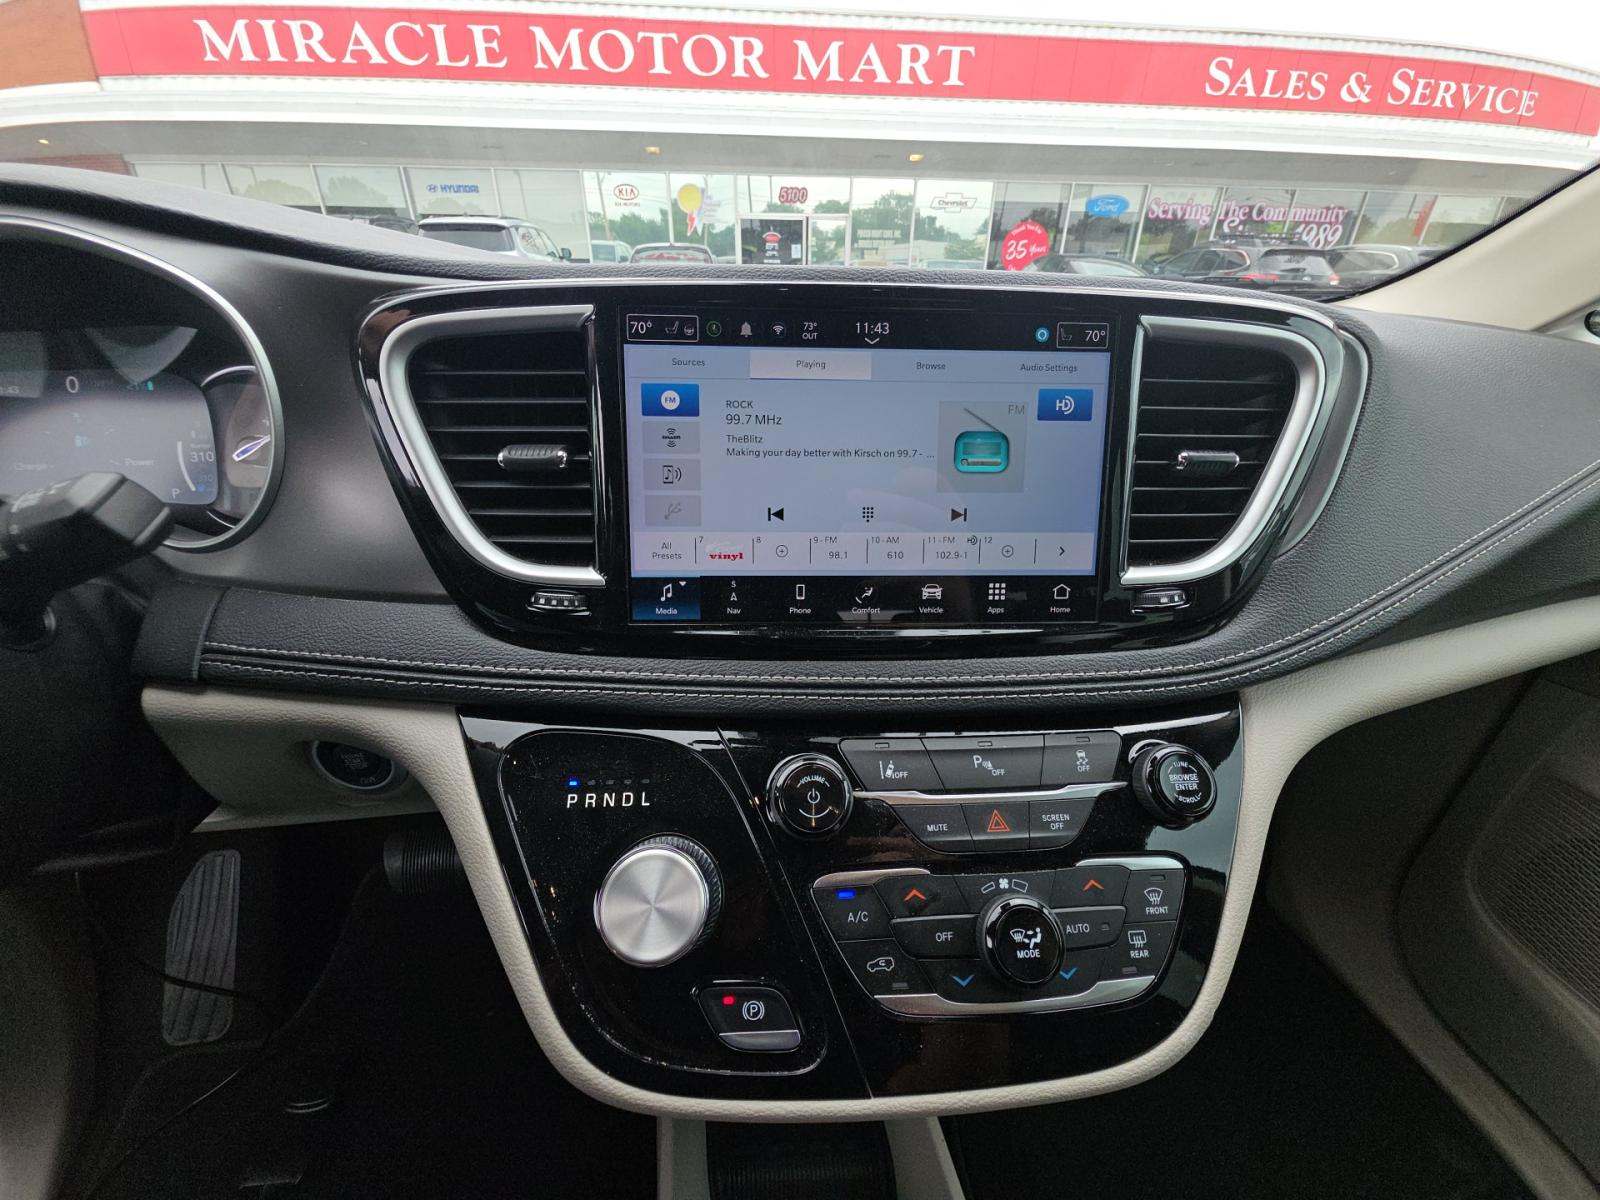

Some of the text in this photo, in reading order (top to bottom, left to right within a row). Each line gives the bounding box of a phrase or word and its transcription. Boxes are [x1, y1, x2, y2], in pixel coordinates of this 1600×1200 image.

[193, 18, 976, 87] MIRACLE MOTOR MART
[1340, 71, 1372, 103] &
[440, 184, 480, 194] HYUNDAI
[618, 187, 637, 197] KIA
[779, 186, 808, 204] 5100
[1148, 196, 1212, 225] Serving
[1218, 200, 1249, 220] The
[1252, 200, 1349, 225] Community
[1005, 239, 1029, 261] 35
[855, 322, 890, 335] 11:43
[802, 332, 818, 340] OUT
[672, 357, 706, 367] Sources
[796, 359, 826, 370] Playing
[916, 361, 946, 370] Browse
[1020, 363, 1078, 374] Audio Settings
[65, 376, 79, 393] 0
[726, 400, 753, 409] ROCK
[1008, 404, 1025, 415] FM
[725, 414, 782, 425] 99.7 MHz
[726, 448, 761, 459] Making
[763, 450, 784, 459] your
[785, 449, 801, 459] day
[803, 448, 830, 457] better
[832, 449, 852, 457] with
[854, 449, 882, 458] Kirsch
[171, 488, 180, 499] P
[698, 536, 704, 544] 7
[652, 551, 682, 560] Presets
[708, 551, 744, 561] vinyl
[828, 551, 849, 560] 98.1
[886, 551, 904, 560] 610
[655, 607, 678, 615] Media
[851, 606, 881, 614] Comfort
[919, 606, 944, 614] Vehicle
[987, 607, 1004, 615] Apps
[1050, 606, 1071, 614] Home
[973, 755, 1006, 776] P OFF
[1077, 764, 1091, 772] OFF
[1173, 760, 1188, 768] TUNE
[894, 771, 909, 779] OFF
[1168, 773, 1198, 782] BROWSE
[800, 775, 826, 785] VOLUME
[1174, 782, 1198, 791] ENTER
[1042, 814, 1070, 822] SCREEN
[926, 823, 948, 832] MUTE
[1050, 822, 1064, 830] OFF
[1145, 906, 1169, 914] FRONT
[847, 911, 869, 923] A/C
[1066, 923, 1090, 933] AUTO
[935, 931, 955, 942] OFF
[1016, 949, 1041, 958] MODE
[1130, 950, 1150, 958] REAR
